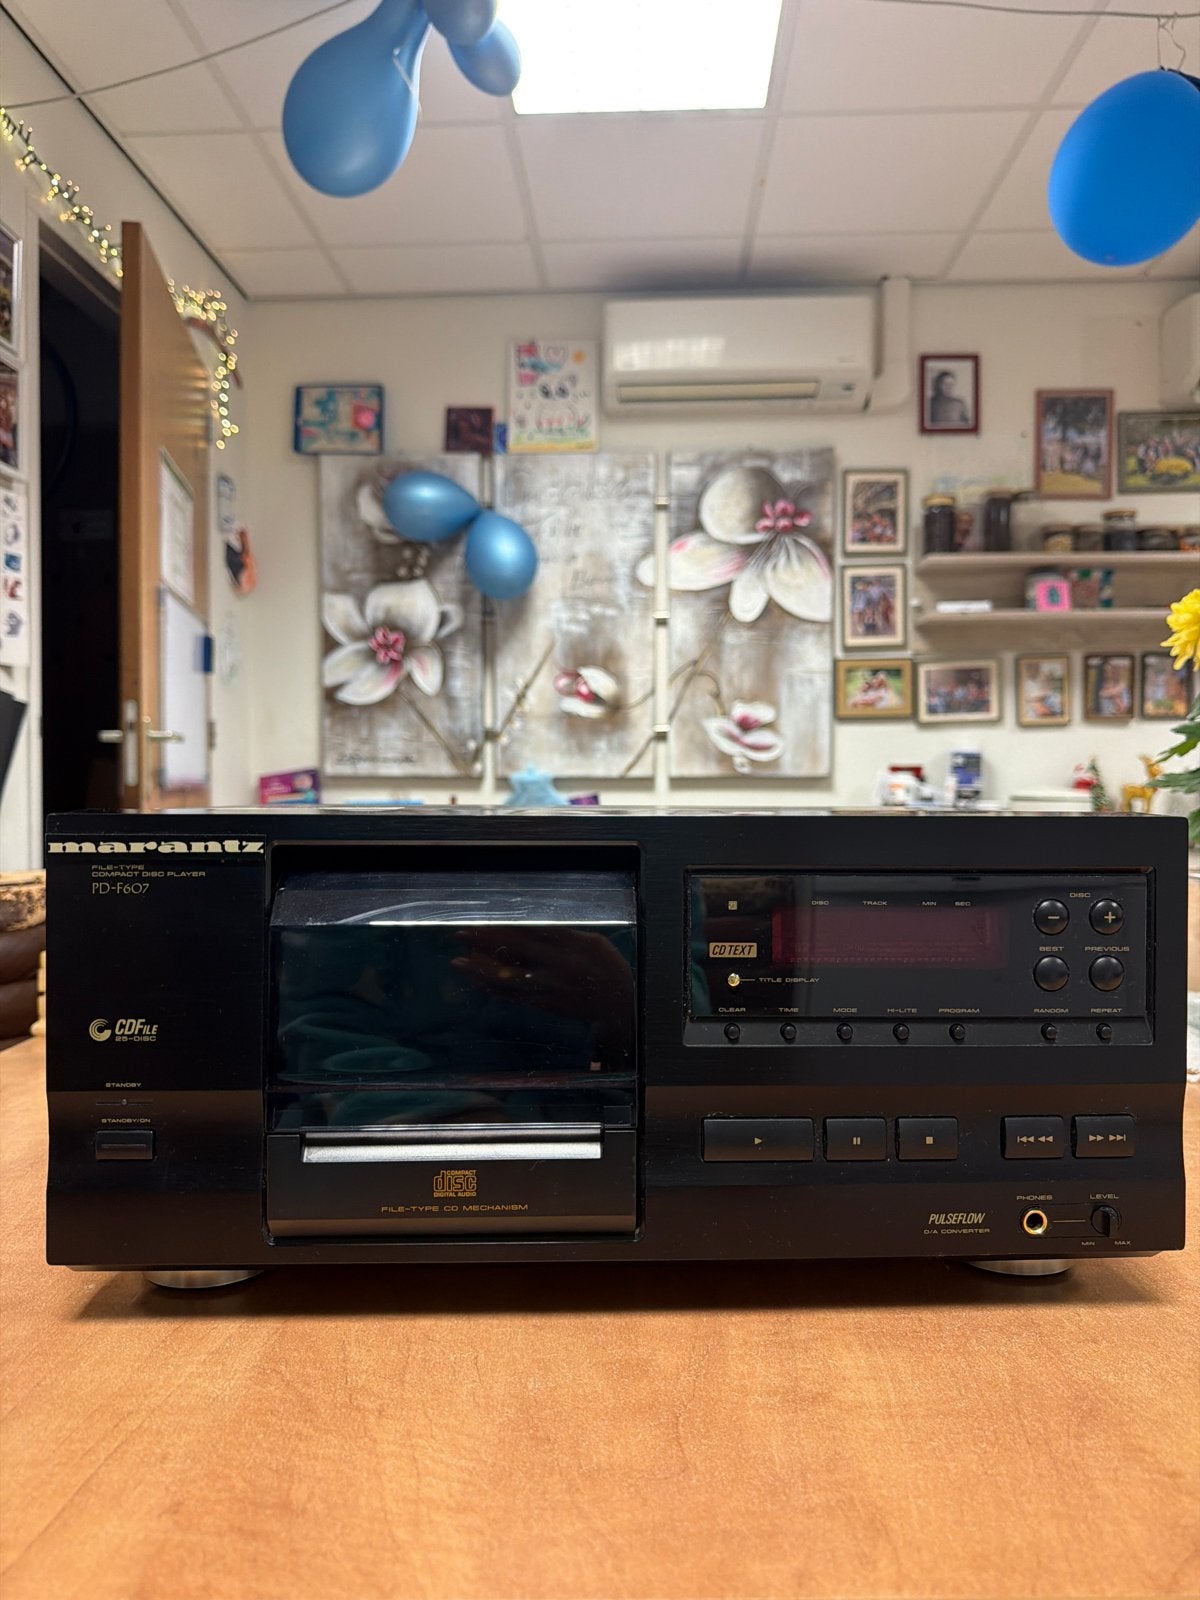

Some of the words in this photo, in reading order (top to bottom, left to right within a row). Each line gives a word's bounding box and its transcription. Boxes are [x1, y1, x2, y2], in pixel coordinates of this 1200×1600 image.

[47, 839, 265, 854] marantz
[91, 882, 150, 895] PD-F607
[711, 944, 726, 956] CD
[727, 944, 754, 956] TEXT
[928, 1213, 985, 1225] PULSEFLOW
